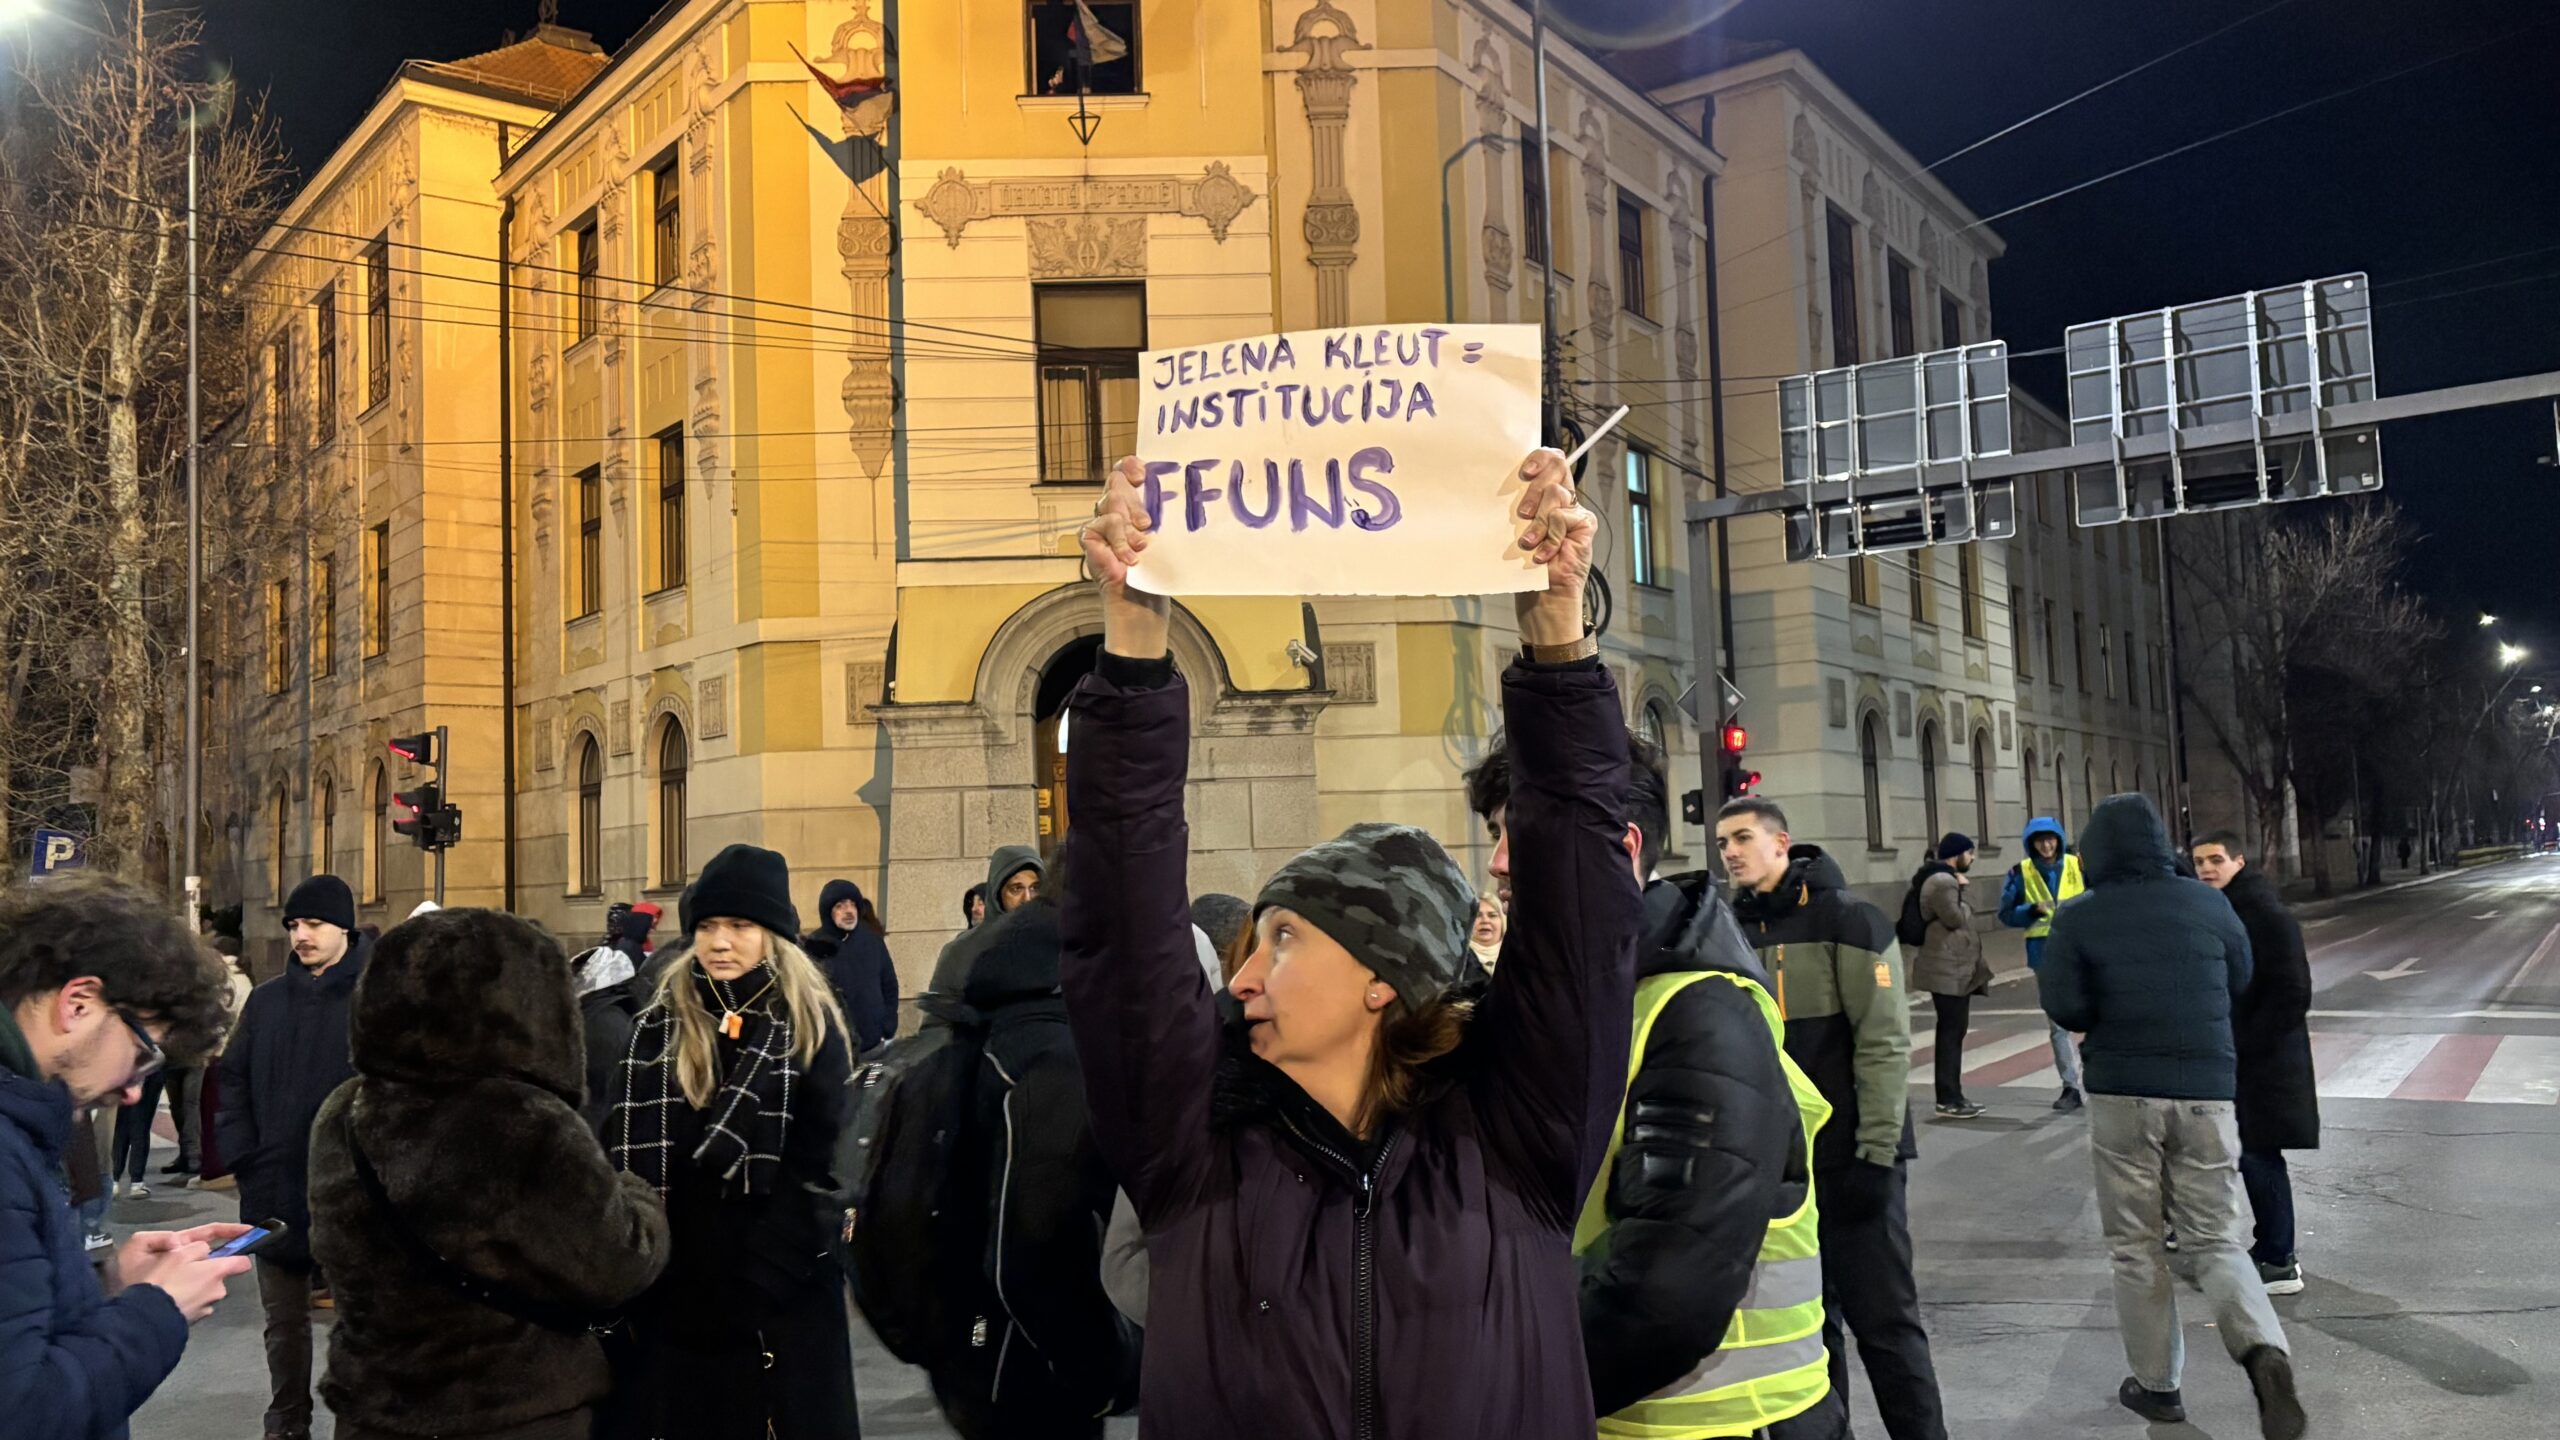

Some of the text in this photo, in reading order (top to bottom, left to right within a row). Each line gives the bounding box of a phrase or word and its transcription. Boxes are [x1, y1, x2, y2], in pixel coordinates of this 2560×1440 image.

[1153, 335, 1295, 390] JELENA
[1325, 328, 1448, 370] KLEUT
[1144, 447, 1403, 533] FFUNS
[45, 836, 75, 870] P
